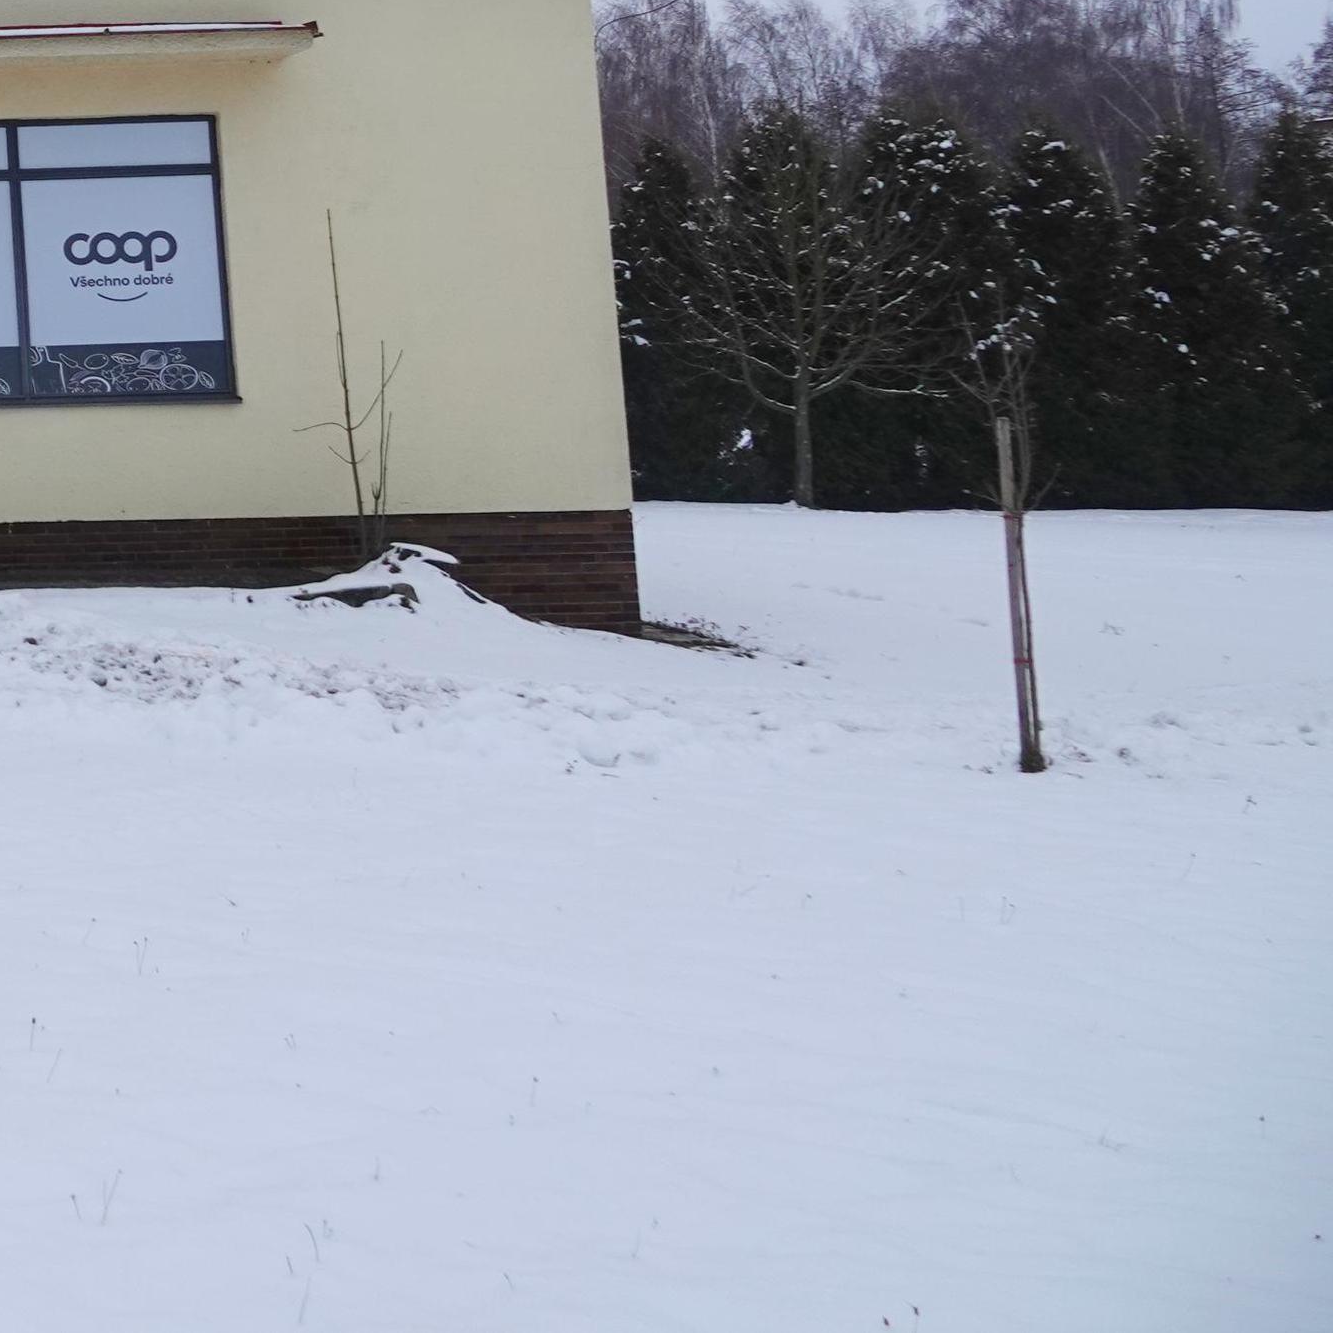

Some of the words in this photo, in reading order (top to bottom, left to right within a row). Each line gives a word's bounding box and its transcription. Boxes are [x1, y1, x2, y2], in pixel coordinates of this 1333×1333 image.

[63, 230, 177, 271] coop
[70, 275, 130, 288] Všechno
[133, 273, 174, 286] dobré
